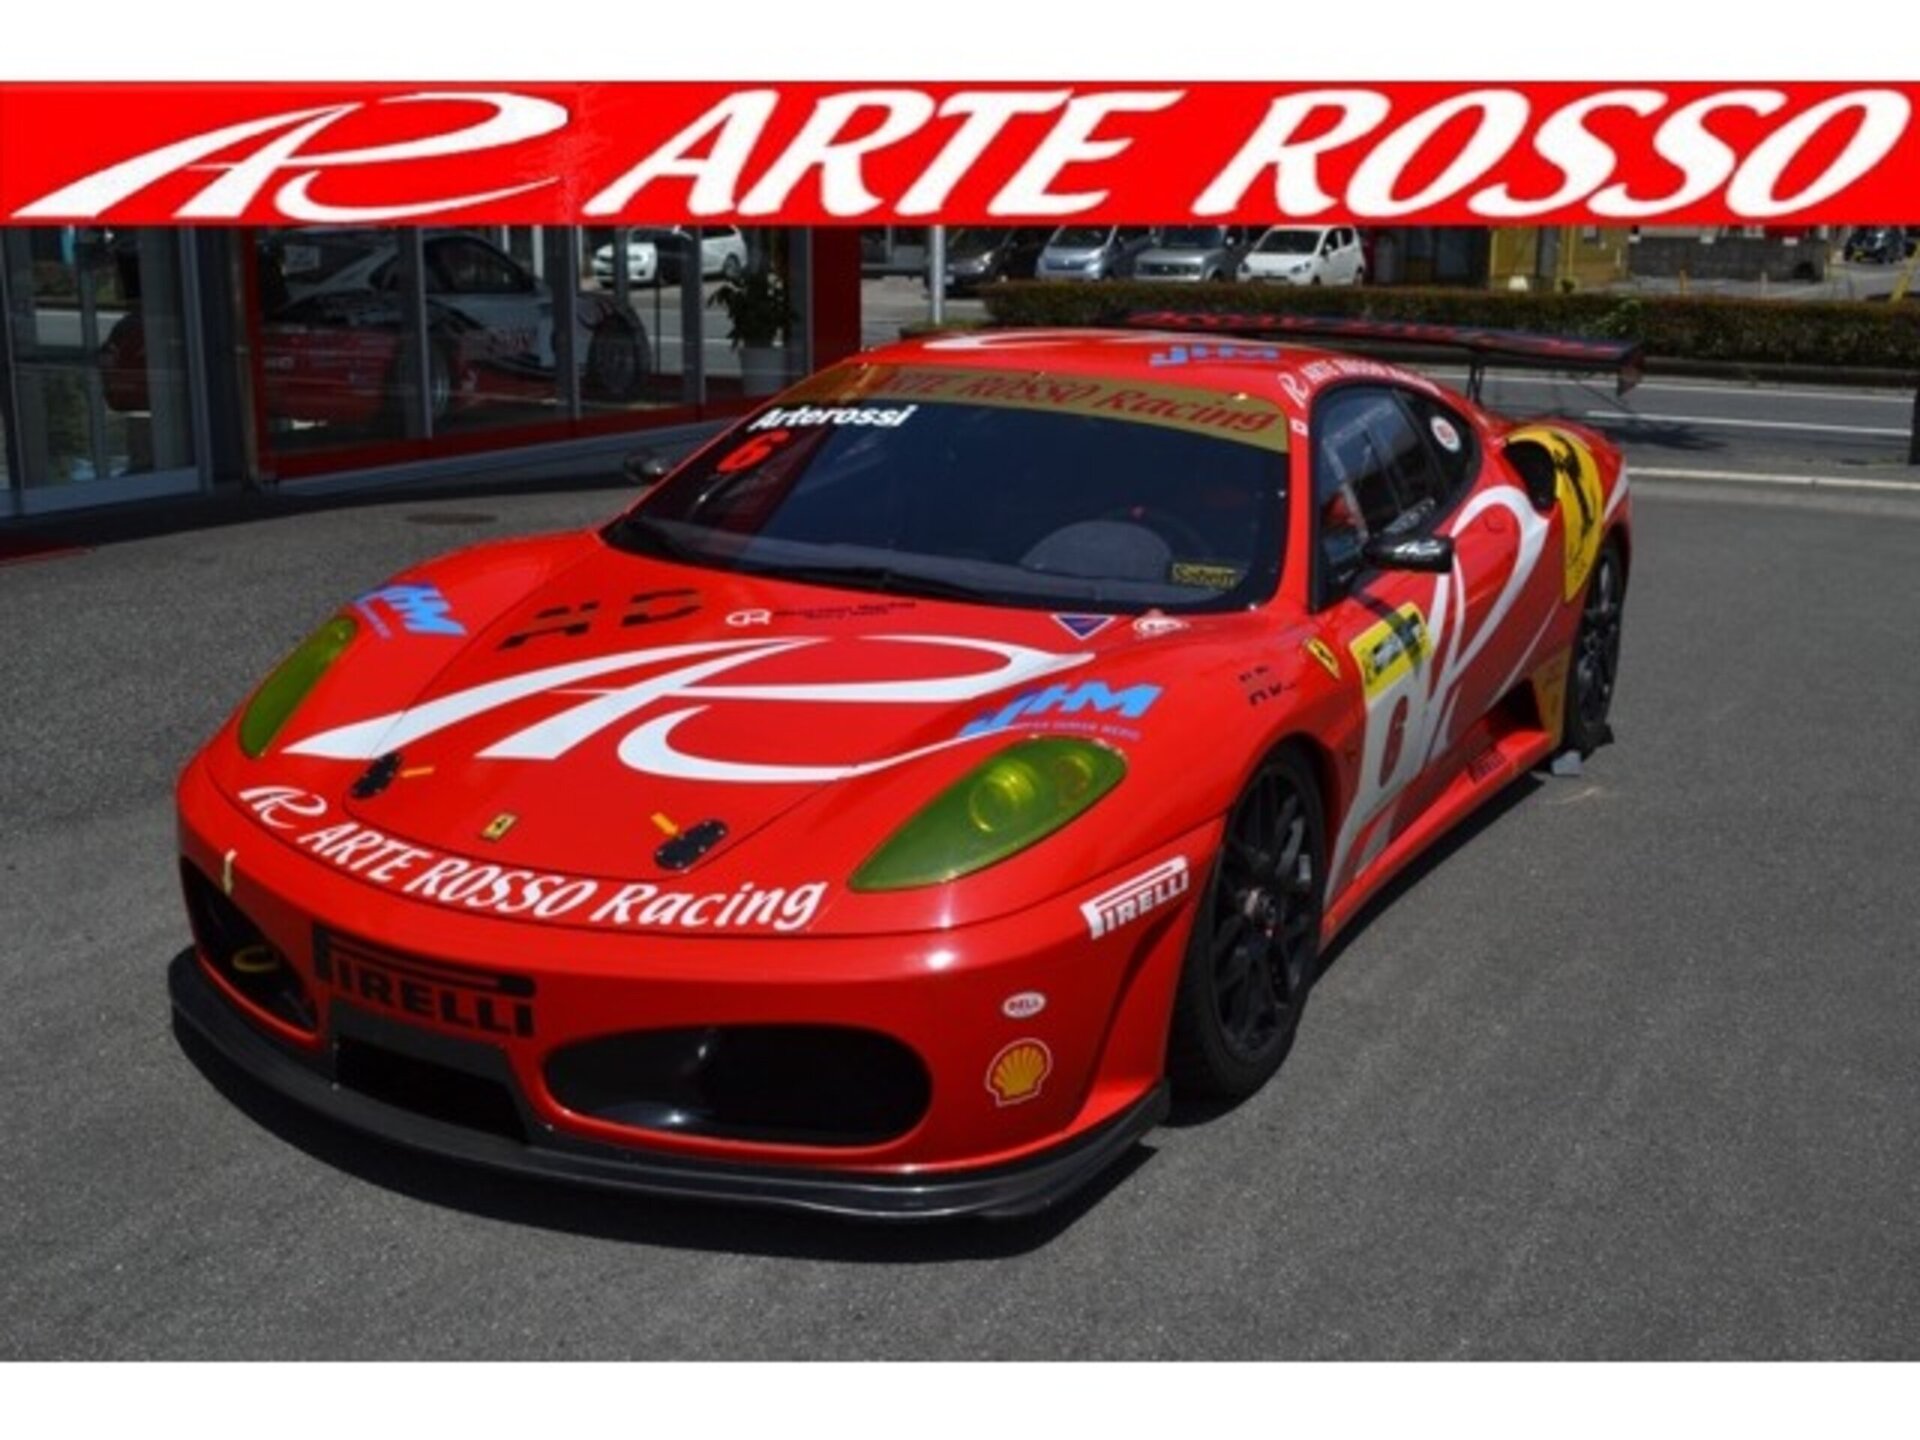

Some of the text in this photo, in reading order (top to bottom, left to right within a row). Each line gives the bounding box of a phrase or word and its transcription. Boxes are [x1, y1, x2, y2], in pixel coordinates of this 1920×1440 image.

[747, 404, 919, 433] Arterossi
[1091, 388, 1283, 433] Racing
[719, 429, 790, 473] 6
[296, 821, 434, 885] ARTE
[403, 852, 598, 918] ROSSO
[589, 879, 829, 931] Racing
[1079, 856, 1190, 941] PIRELLI
[313, 925, 536, 1037] PIRELLI
